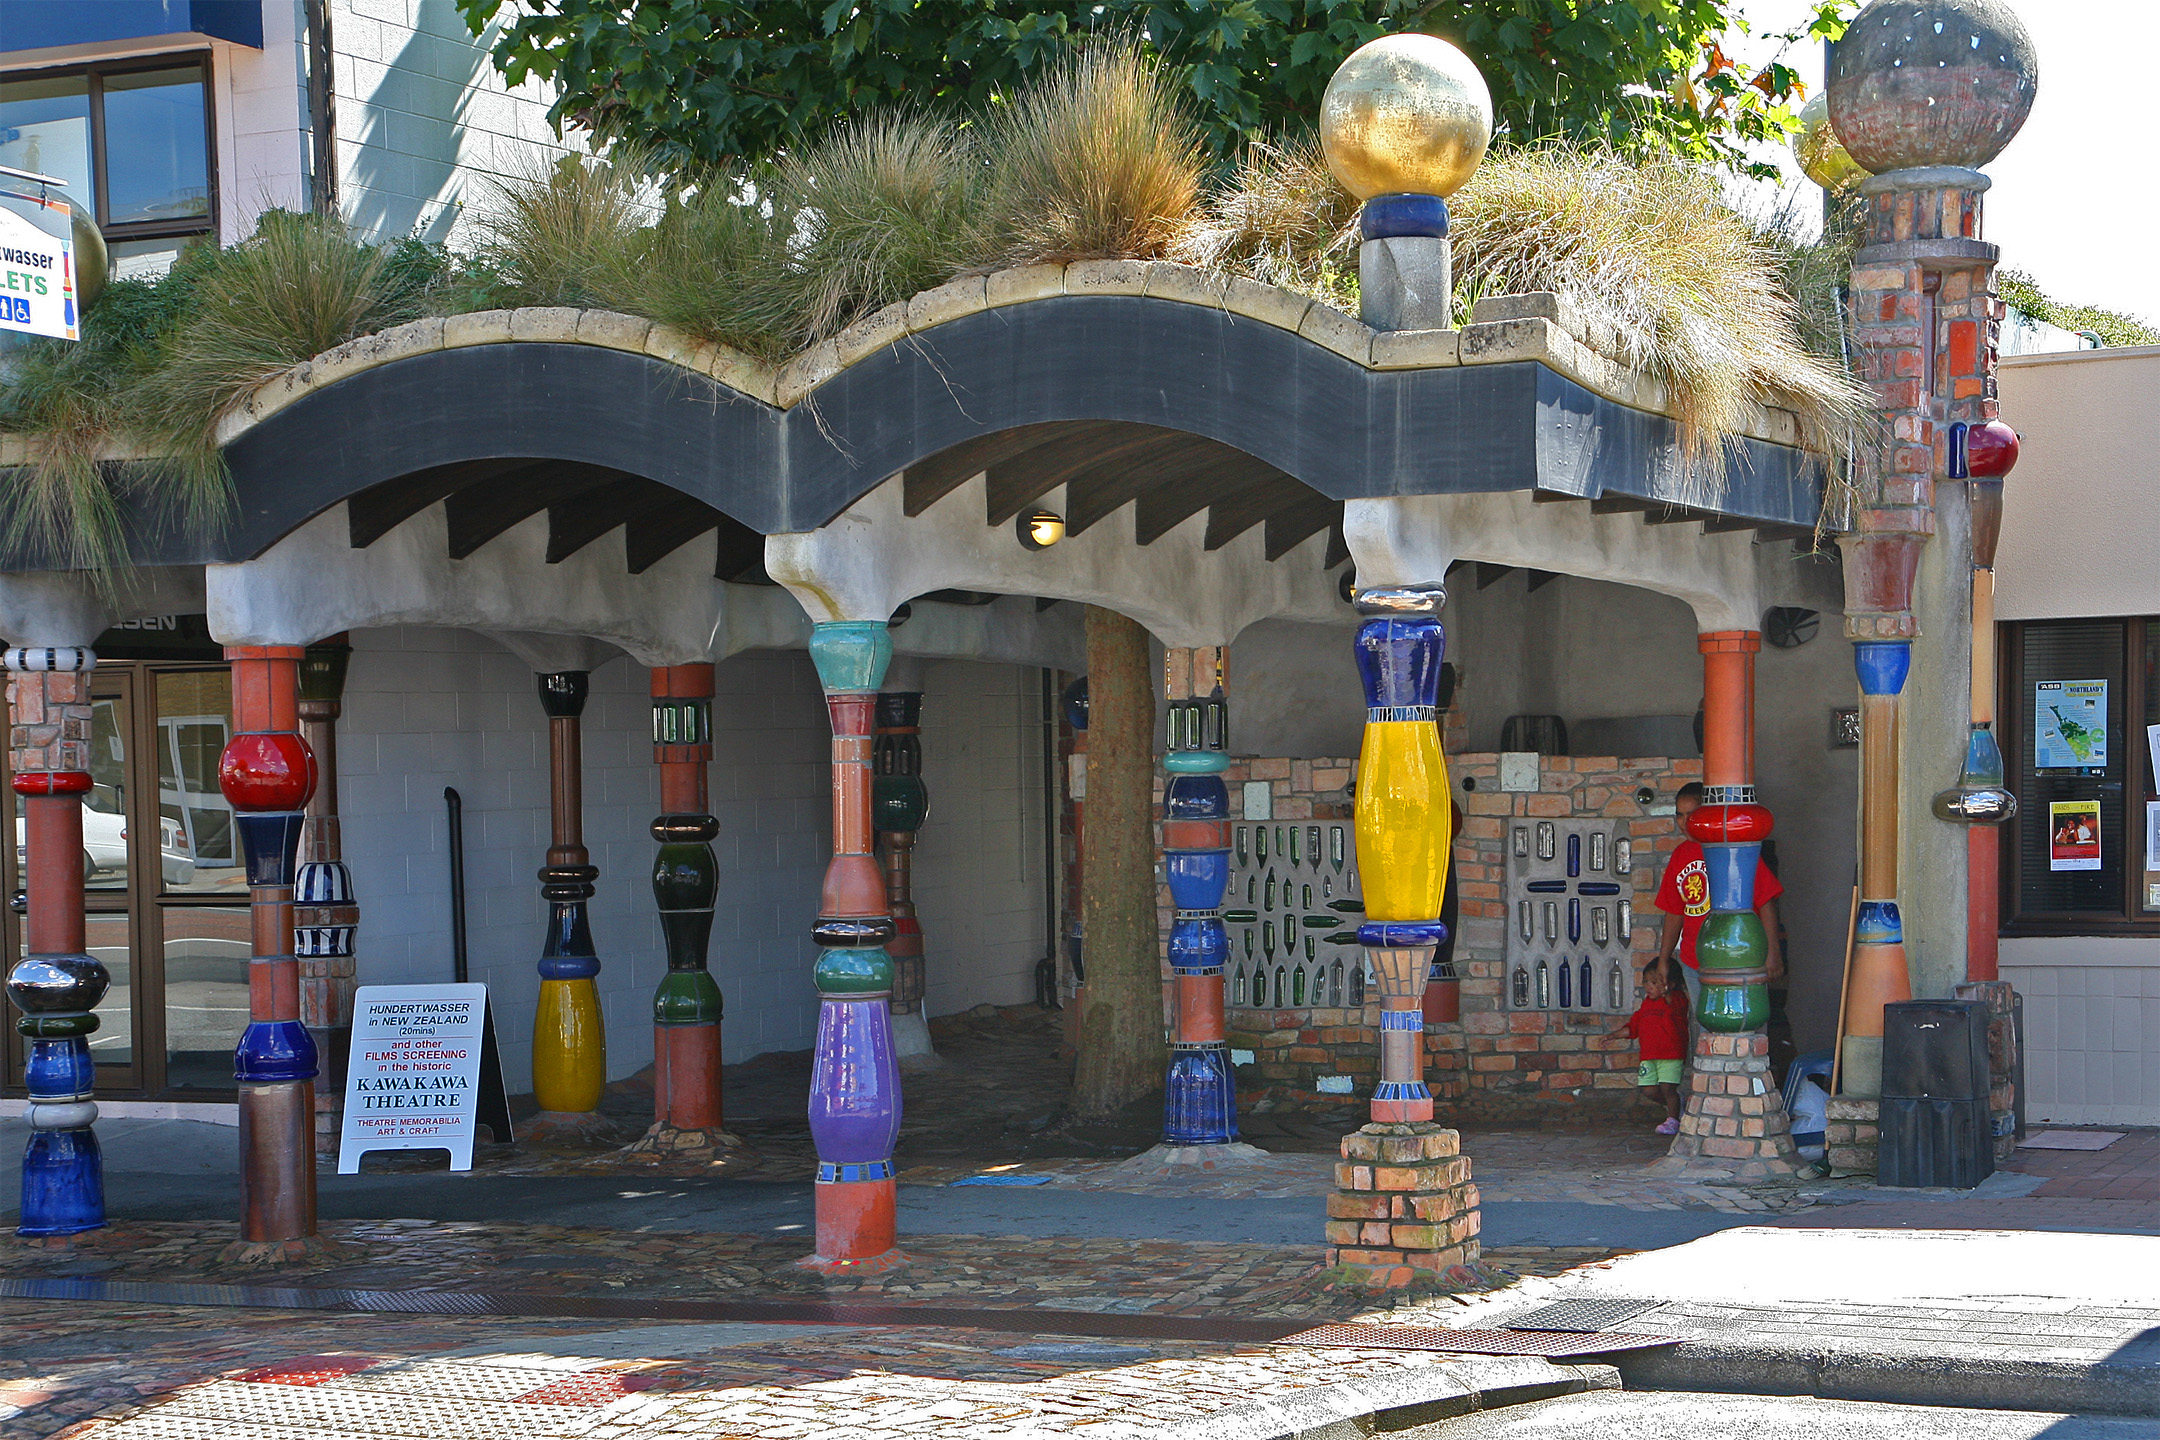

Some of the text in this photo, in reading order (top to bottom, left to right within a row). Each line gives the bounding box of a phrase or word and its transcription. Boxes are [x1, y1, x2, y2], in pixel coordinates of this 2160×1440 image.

[368, 1003, 470, 1014] HUNDERTWASSER
[368, 1015, 469, 1026] in NEW ZEALAND
[399, 1027, 436, 1036] (20mins)
[391, 1040, 442, 1049] and other
[365, 1050, 467, 1061] FILMS SCREENING
[392, 1063, 408, 1071] the
[413, 1062, 451, 1070] historic
[356, 1075, 470, 1091] KAWAKAWA
[362, 1093, 461, 1108] THEATRE
[357, 1117, 461, 1127] THEATRE MEMORABILIA
[377, 1128, 396, 1136] ART
[409, 1127, 440, 1135] CRAFT
